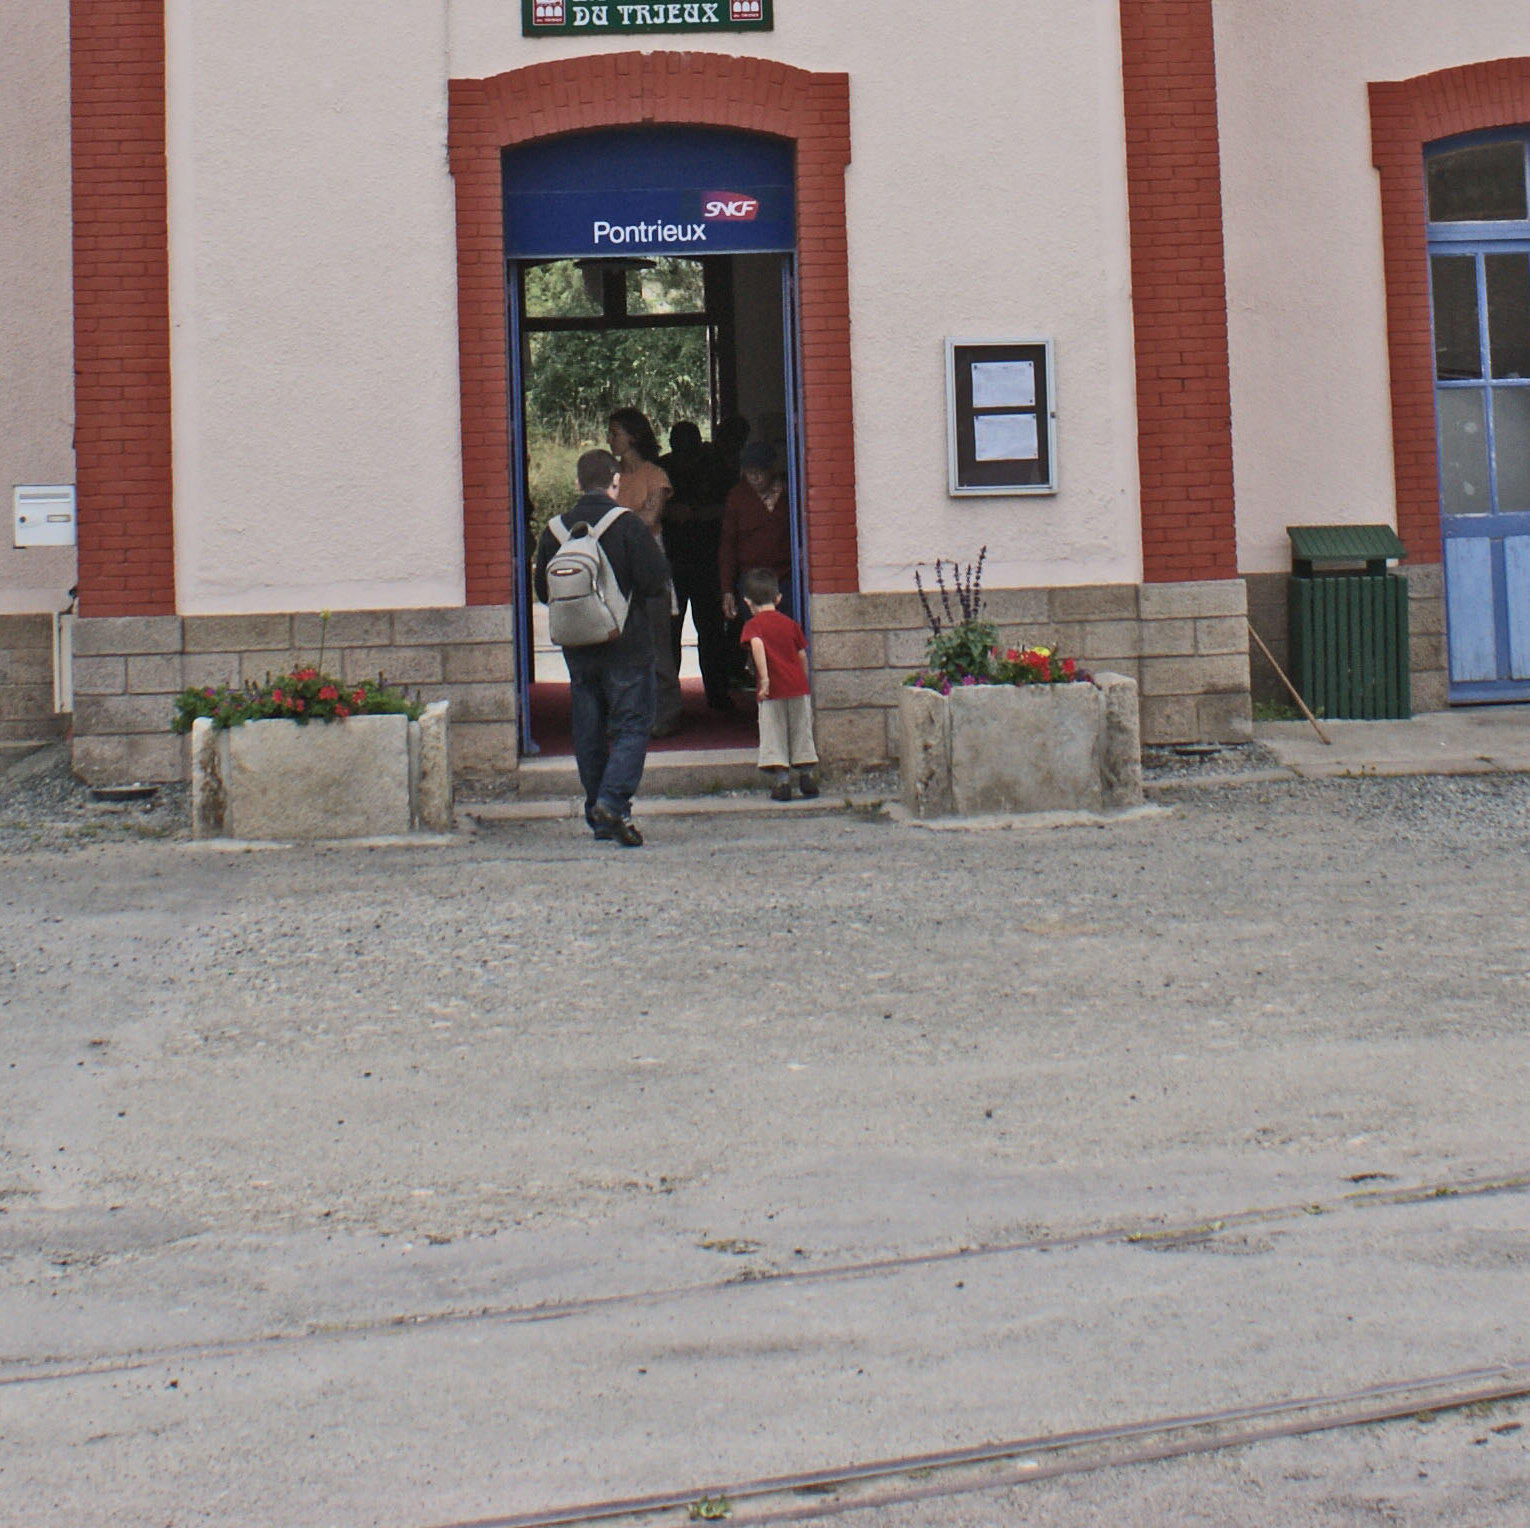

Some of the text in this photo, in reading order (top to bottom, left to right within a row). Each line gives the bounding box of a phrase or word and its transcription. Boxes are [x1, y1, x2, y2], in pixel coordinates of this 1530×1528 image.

[572, 5, 609, 26] DU
[704, 200, 757, 217] SNCF
[593, 219, 707, 244] Pontrieux
